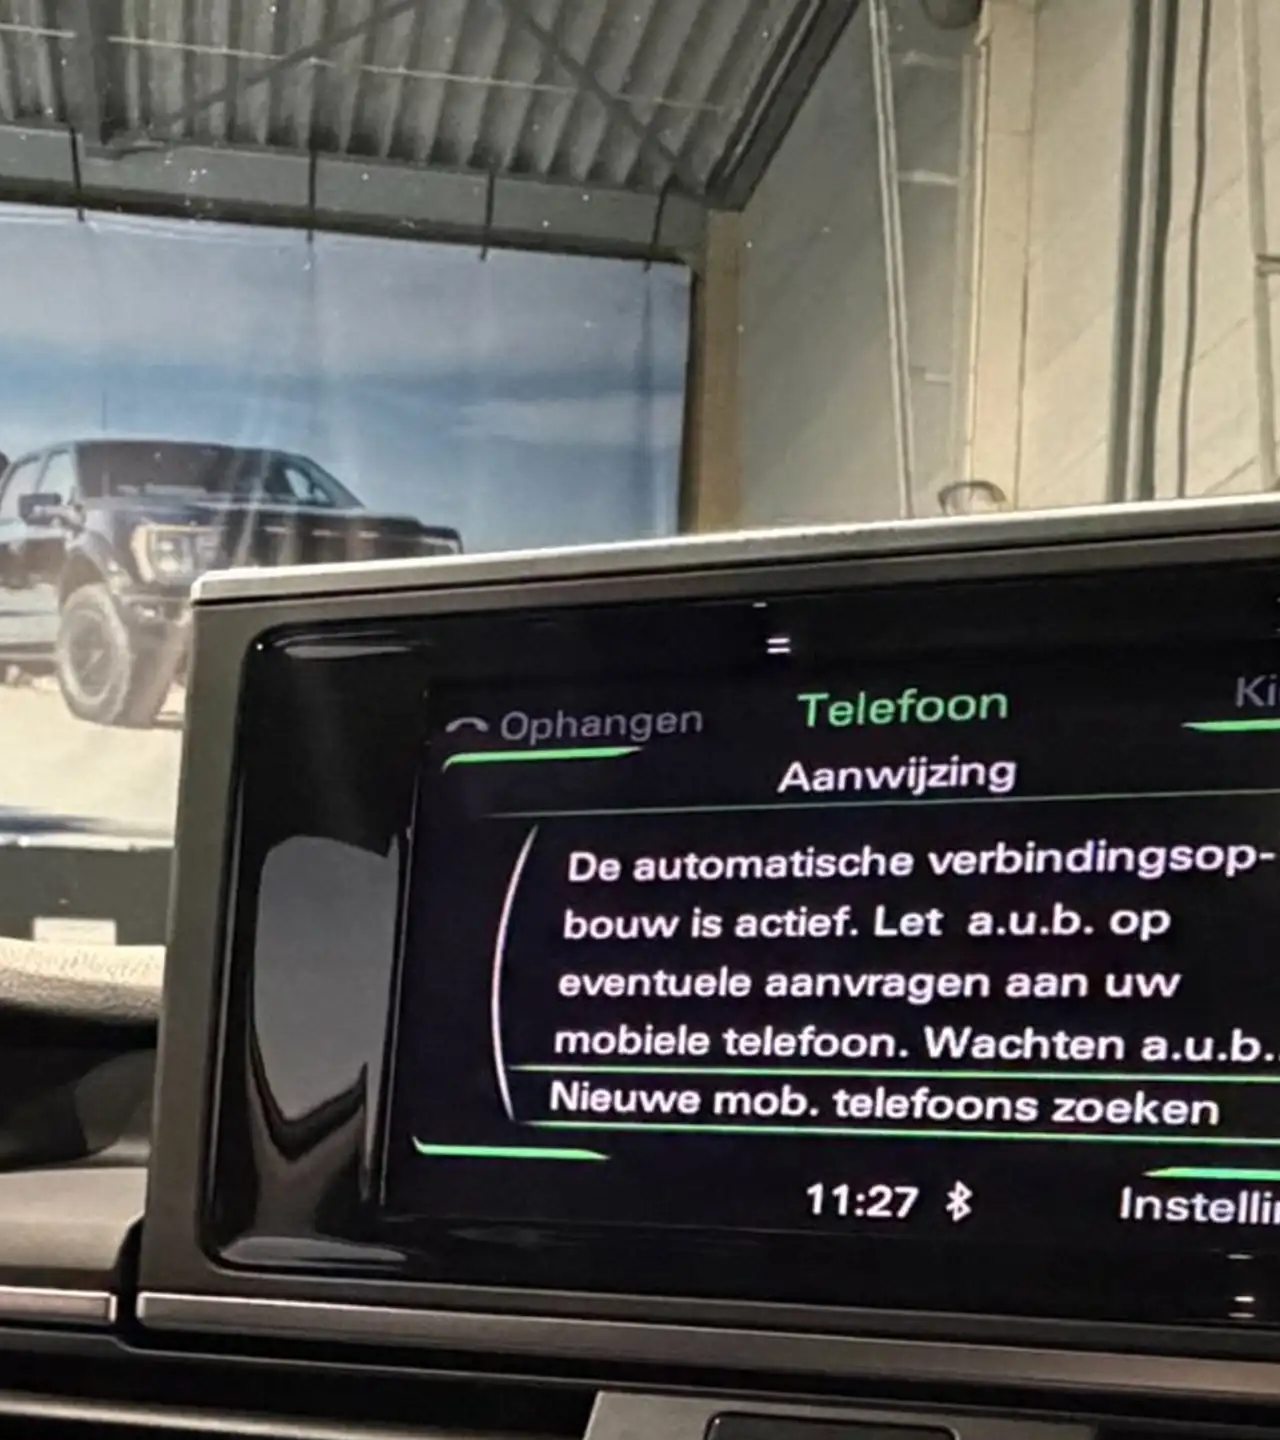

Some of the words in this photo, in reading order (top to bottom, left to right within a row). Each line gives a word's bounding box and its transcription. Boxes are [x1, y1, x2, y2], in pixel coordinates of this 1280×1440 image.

[798, 688, 1007, 726] Telefoon
[499, 710, 703, 745] Ophangen
[777, 756, 1016, 796] Aanwijzing
[569, 852, 620, 881] De
[634, 846, 913, 880] automatische
[928, 840, 1274, 879] verbindingsop-
[564, 909, 679, 939] bouw
[692, 908, 722, 937] is
[735, 906, 857, 937] actief.
[875, 906, 943, 936] Let
[968, 903, 1092, 935] a.u.b.
[1110, 910, 1170, 941] op
[559, 966, 751, 996] eventuele
[765, 974, 989, 1004] aanvragen
[1006, 974, 1087, 997] aan
[1106, 974, 1180, 997] uw
[555, 1024, 710, 1055] mobiele
[723, 1025, 907, 1057] telefoon.
[925, 1026, 1124, 1059] Wachten
[549, 1081, 702, 1115] Nieuwe
[713, 1085, 819, 1117] mob.
[833, 1086, 1038, 1121] telefoons
[1051, 1090, 1220, 1125] zoeken
[808, 1183, 918, 1217] 11:27
